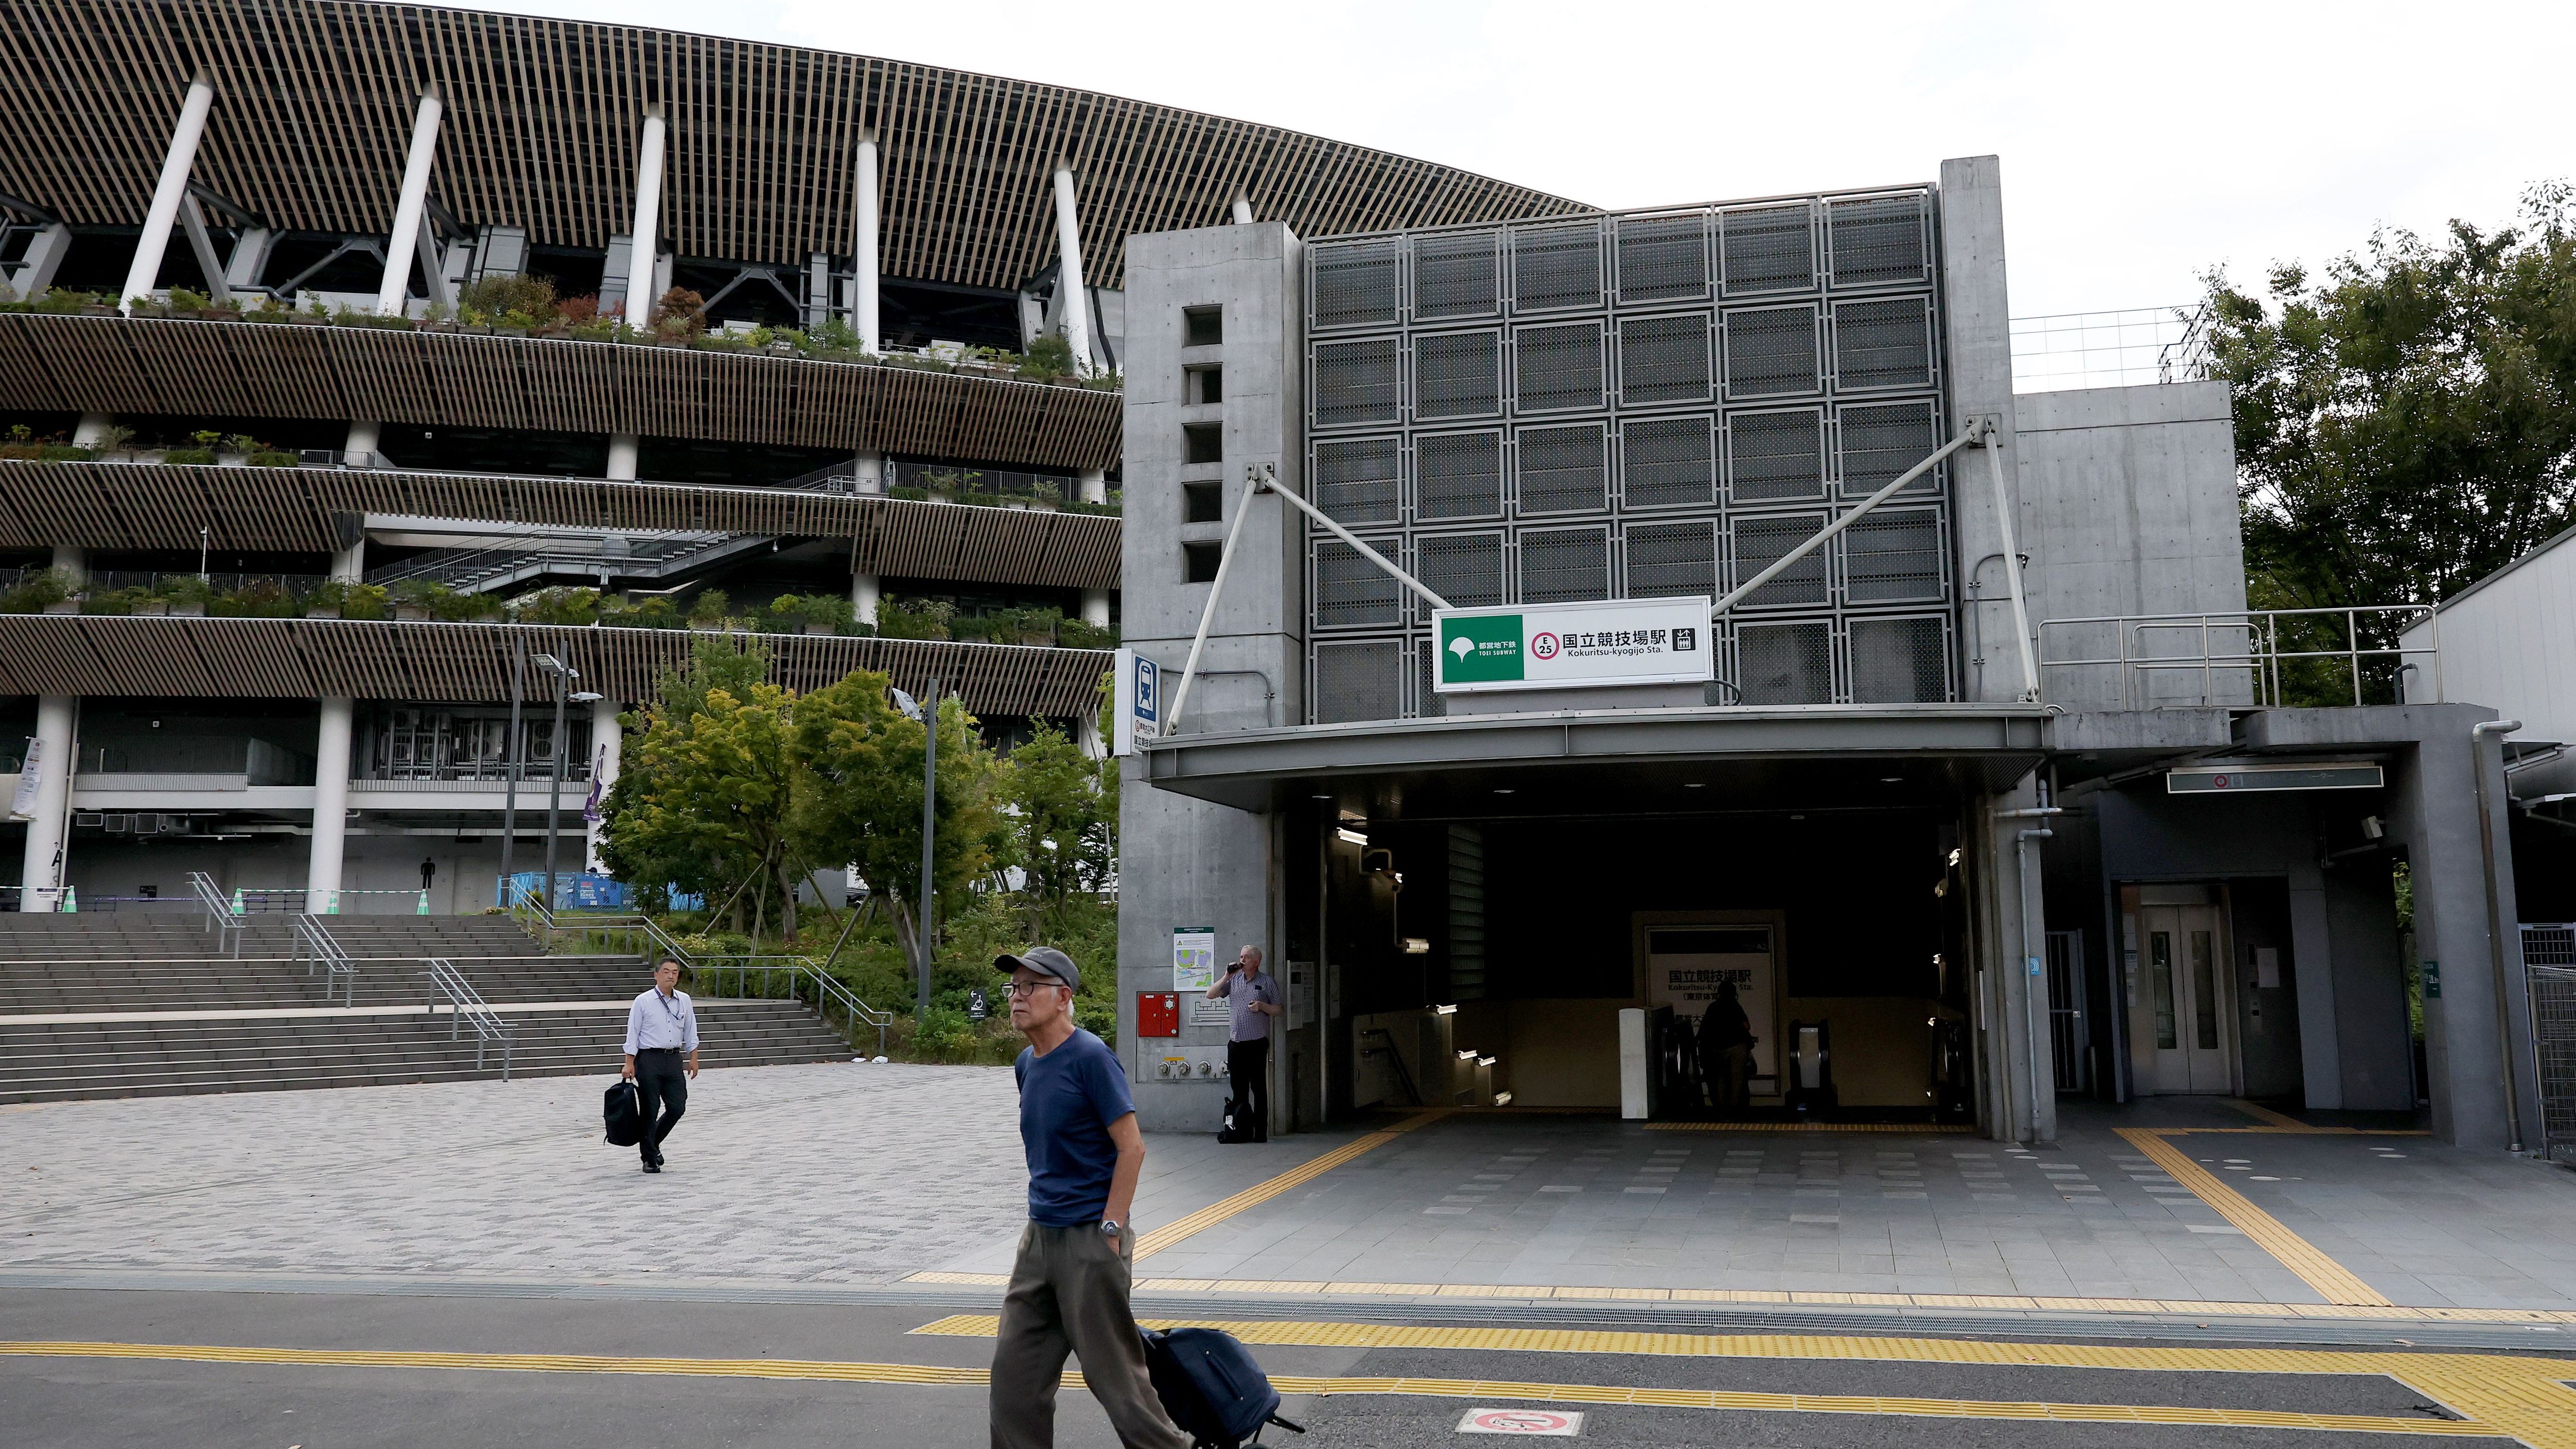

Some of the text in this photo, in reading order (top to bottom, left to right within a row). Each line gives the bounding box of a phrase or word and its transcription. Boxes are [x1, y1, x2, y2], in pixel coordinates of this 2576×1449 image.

[1563, 630, 1667, 649] 国立競技場駅
[1479, 641, 1516, 650] 都営地下鉄
[1539, 645, 1552, 654] 25
[1568, 647, 1644, 657] Kokuritsu-kyogijo
[1669, 970, 1751, 983] 国立競技場駅
